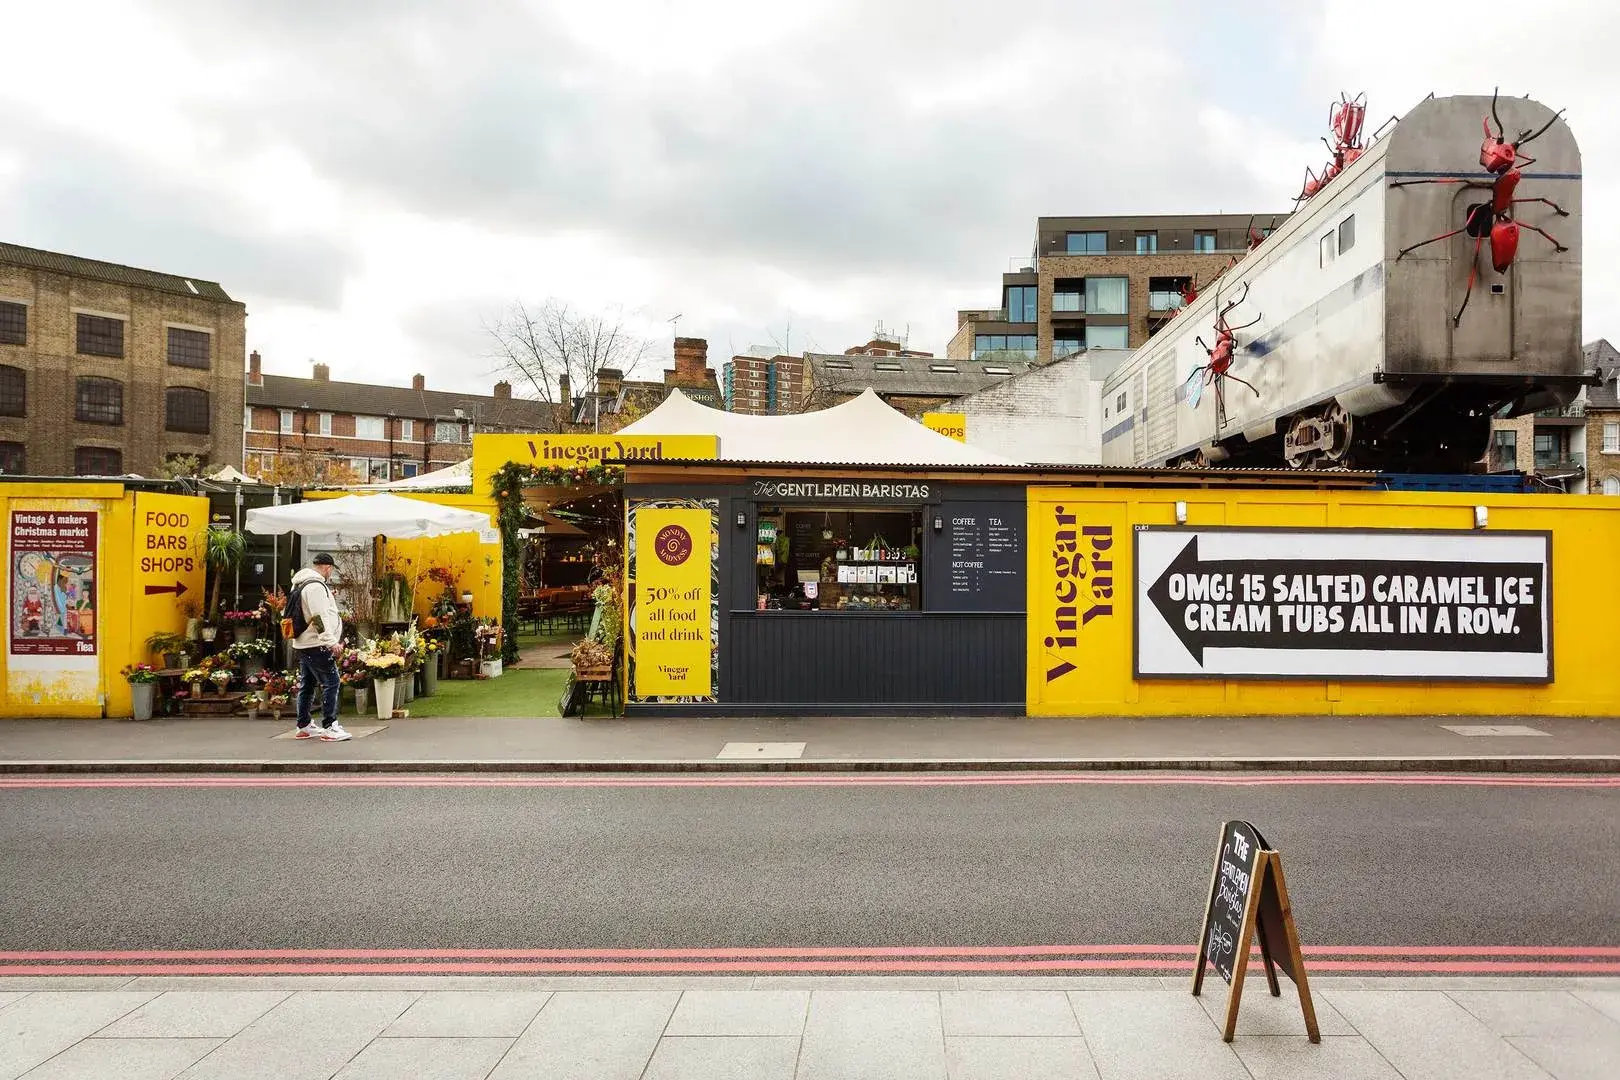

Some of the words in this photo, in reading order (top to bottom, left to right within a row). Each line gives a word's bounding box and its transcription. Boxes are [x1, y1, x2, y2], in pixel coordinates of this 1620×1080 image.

[527, 440, 611, 465] Vinegar
[614, 441, 663, 459] Yard
[754, 481, 777, 497] The
[777, 483, 860, 497] GENTLEMEN
[862, 485, 930, 498] BARISTAS
[15, 514, 46, 525] Vintage
[48, 514, 55, 524] &
[57, 515, 88, 524] makers
[146, 511, 190, 528] FOOD
[952, 518, 976, 526] COFFEE
[988, 518, 1002, 526] TEA
[14, 527, 57, 537] Christmas
[59, 527, 89, 537] market
[660, 529, 687, 541] MONDAY
[147, 534, 187, 550] BARS
[660, 548, 688, 562] MADNESS
[141, 557, 194, 572] SHOPS
[964, 561, 984, 569] COFFEE
[646, 588, 680, 605] 50%
[684, 588, 701, 600] off
[1044, 505, 1087, 686] Vinegar
[1082, 526, 1113, 630] Yard
[1168, 574, 1234, 601] OMG!
[1240, 575, 1265, 601] 15
[1272, 575, 1366, 604] SALTED
[1372, 575, 1490, 604] CARAMEL
[1495, 577, 1534, 605] ICE
[649, 608, 664, 621] all
[669, 608, 696, 621] food
[1184, 604, 1271, 633] CREAM
[1278, 605, 1345, 633] TUBS
[1350, 605, 1394, 633] ALL
[1400, 606, 1427, 634] IN
[1434, 606, 1451, 634] A
[1457, 607, 1520, 635] ROW.
[642, 628, 665, 640] and
[669, 628, 704, 640] drink
[76, 641, 94, 652] flea
[658, 665, 689, 673] Vinegar
[1234, 830, 1249, 862] THE
